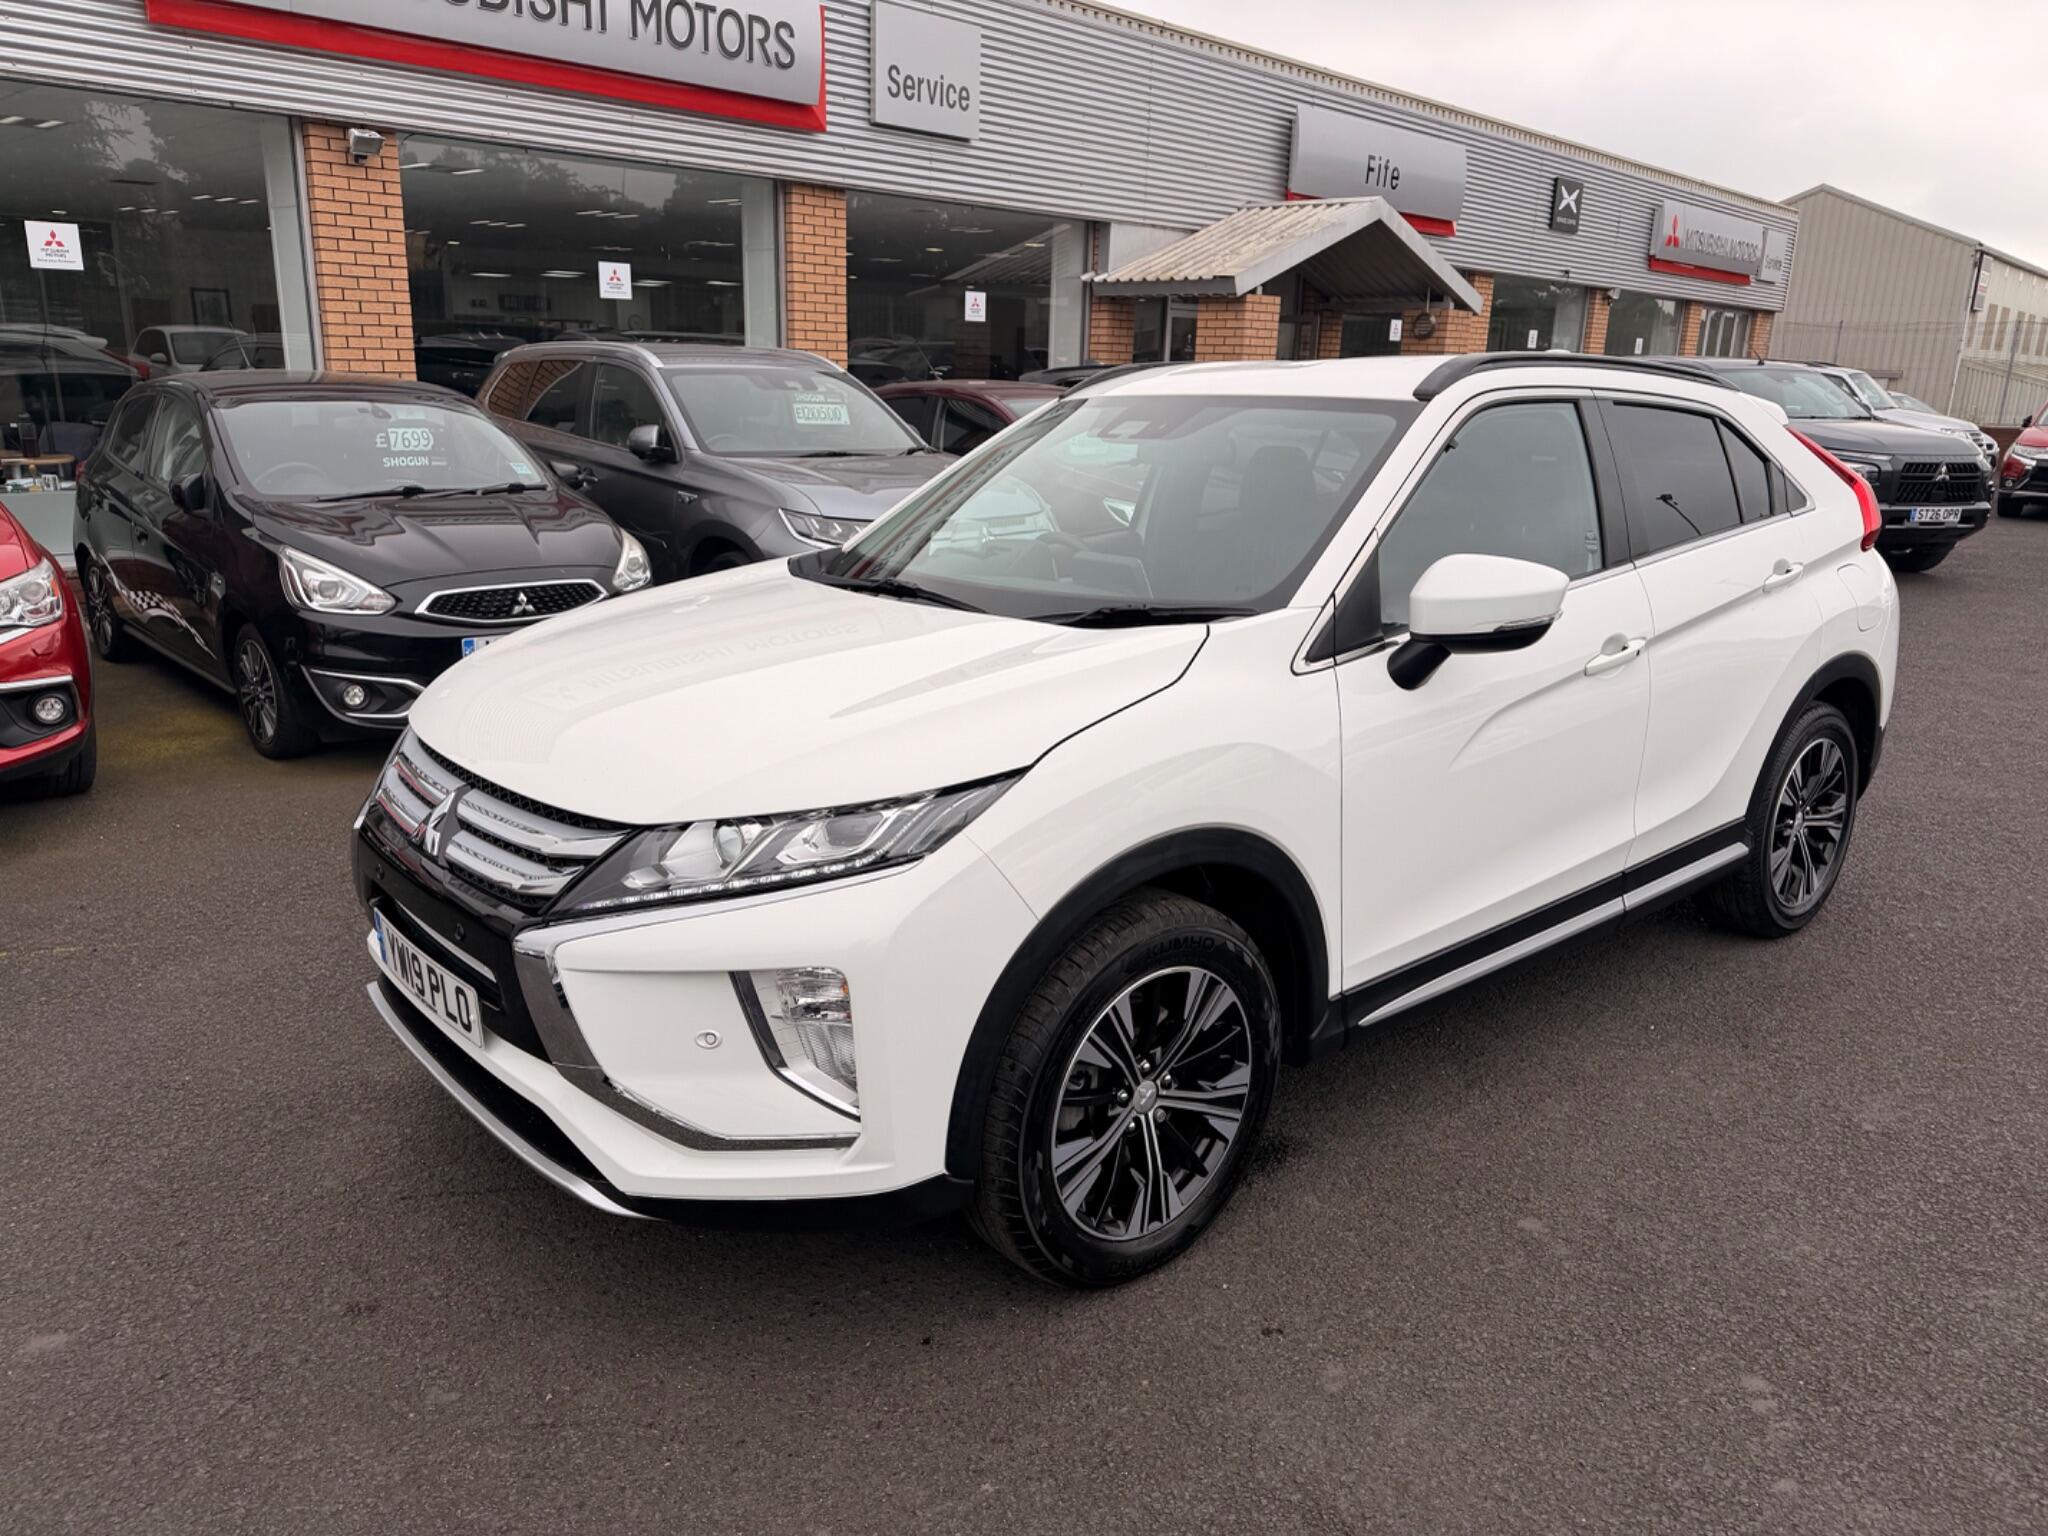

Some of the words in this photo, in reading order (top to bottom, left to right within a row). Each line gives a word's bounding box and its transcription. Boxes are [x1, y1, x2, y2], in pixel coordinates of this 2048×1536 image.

[628, 0, 797, 70] MOTORS
[887, 64, 970, 112] Service
[1365, 154, 1400, 190] Fife
[382, 456, 430, 468] SHOGUN
[426, 963, 473, 1034] PLO
